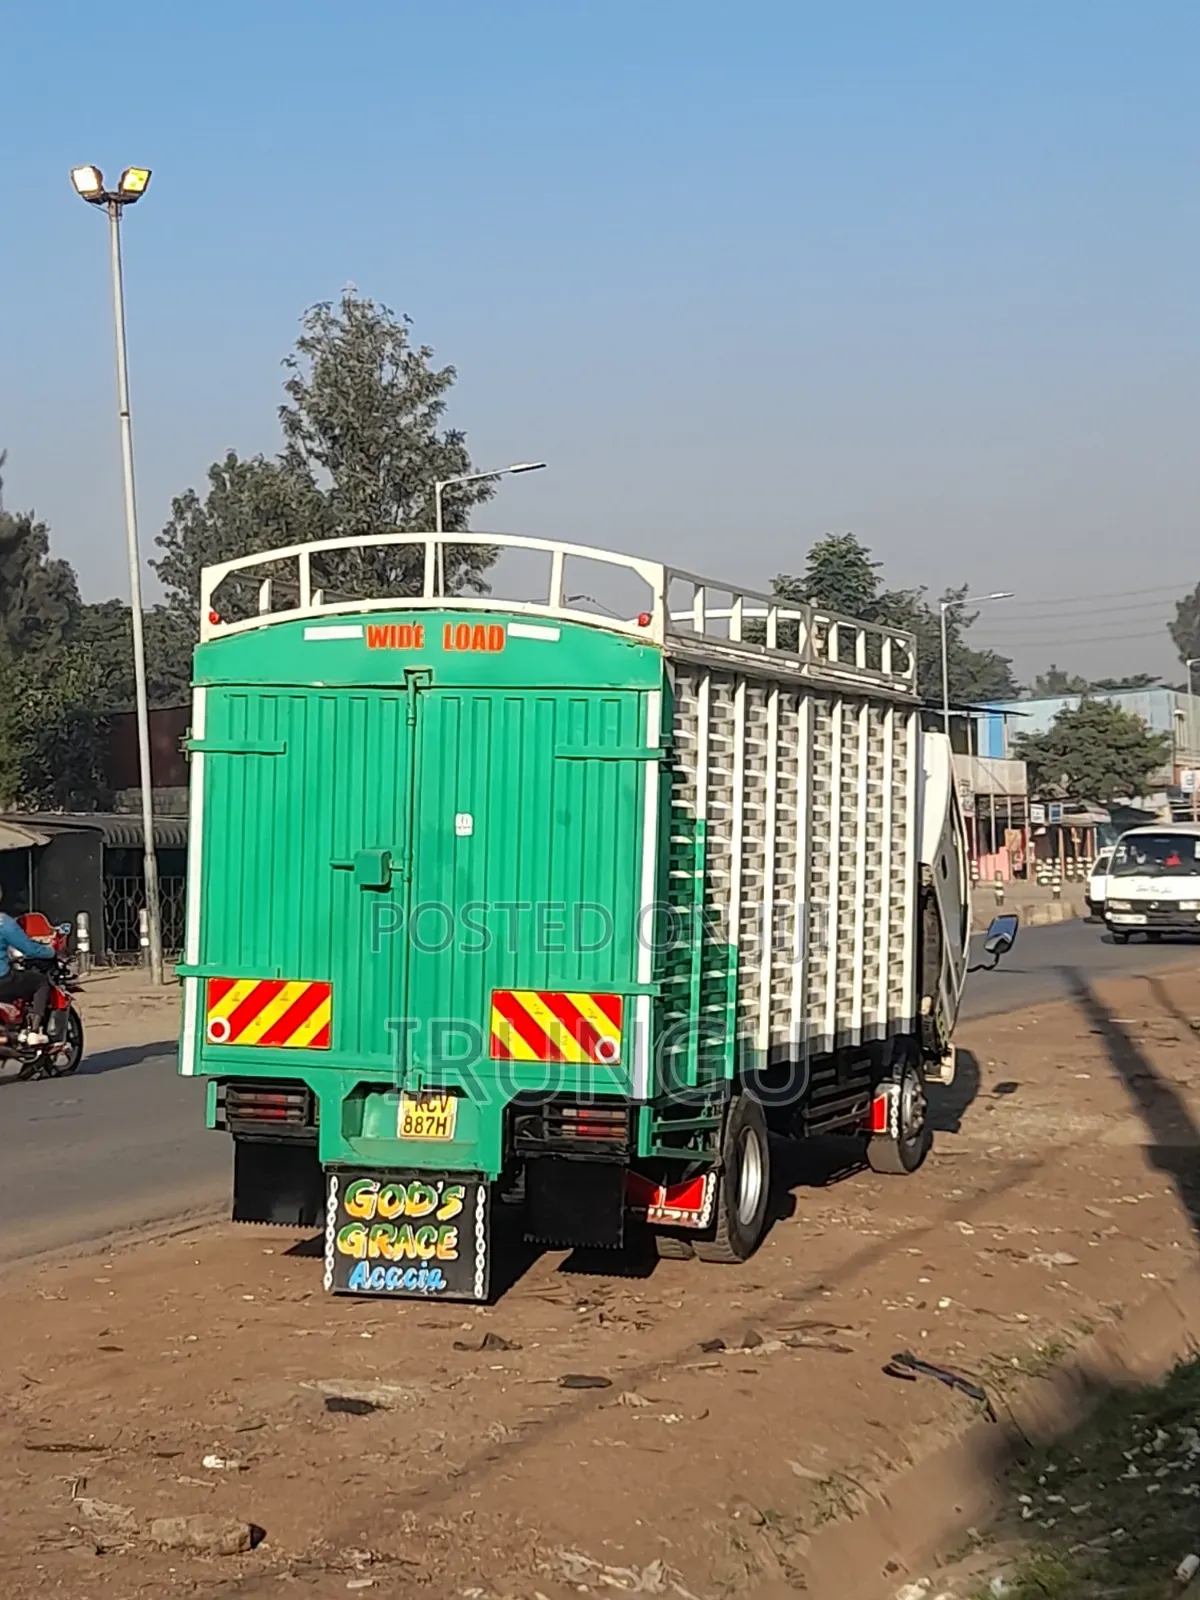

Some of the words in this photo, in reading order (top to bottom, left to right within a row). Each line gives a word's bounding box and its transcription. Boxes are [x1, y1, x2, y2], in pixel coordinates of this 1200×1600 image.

[366, 623, 425, 650] WIDE
[442, 622, 506, 652] LOAD
[403, 1115, 448, 1136] 887H
[343, 1178, 467, 1221] GOD'S
[336, 1221, 459, 1262] GRACE
[348, 1260, 447, 1292] Acacia
